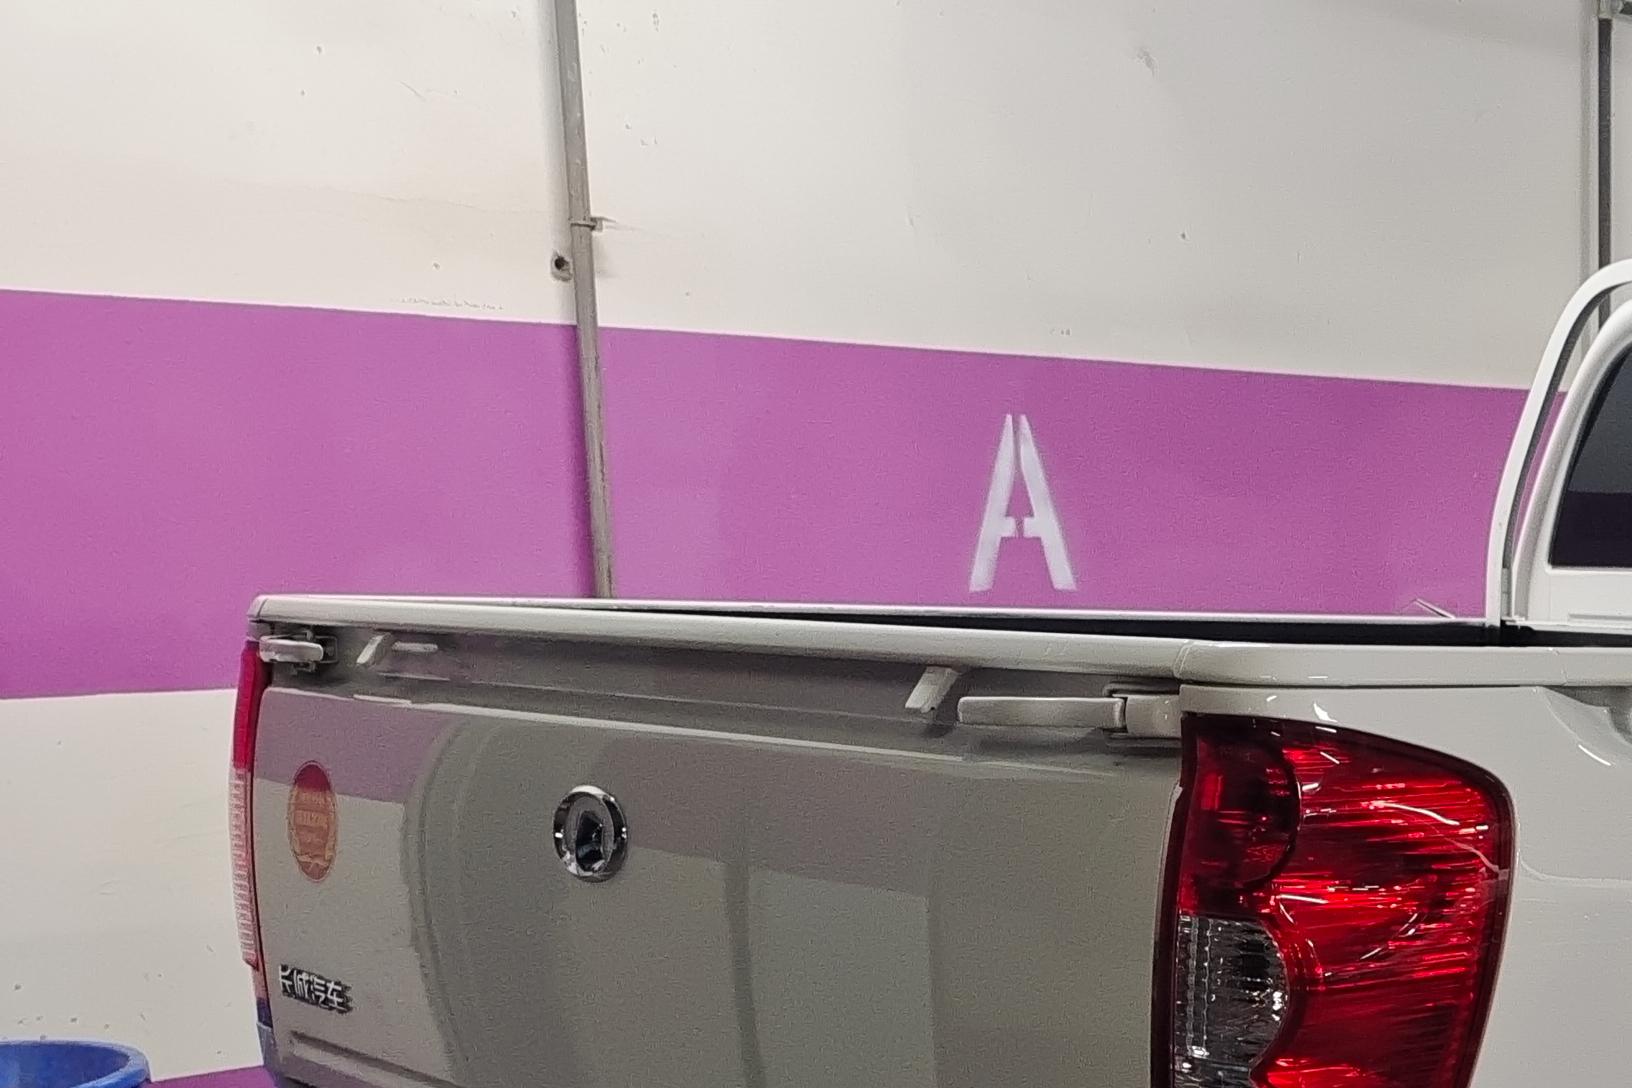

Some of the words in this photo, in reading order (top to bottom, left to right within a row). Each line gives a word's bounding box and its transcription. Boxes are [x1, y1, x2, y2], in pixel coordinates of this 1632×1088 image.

[969, 413, 1077, 592] A
[279, 965, 350, 1013] 长城汽车
